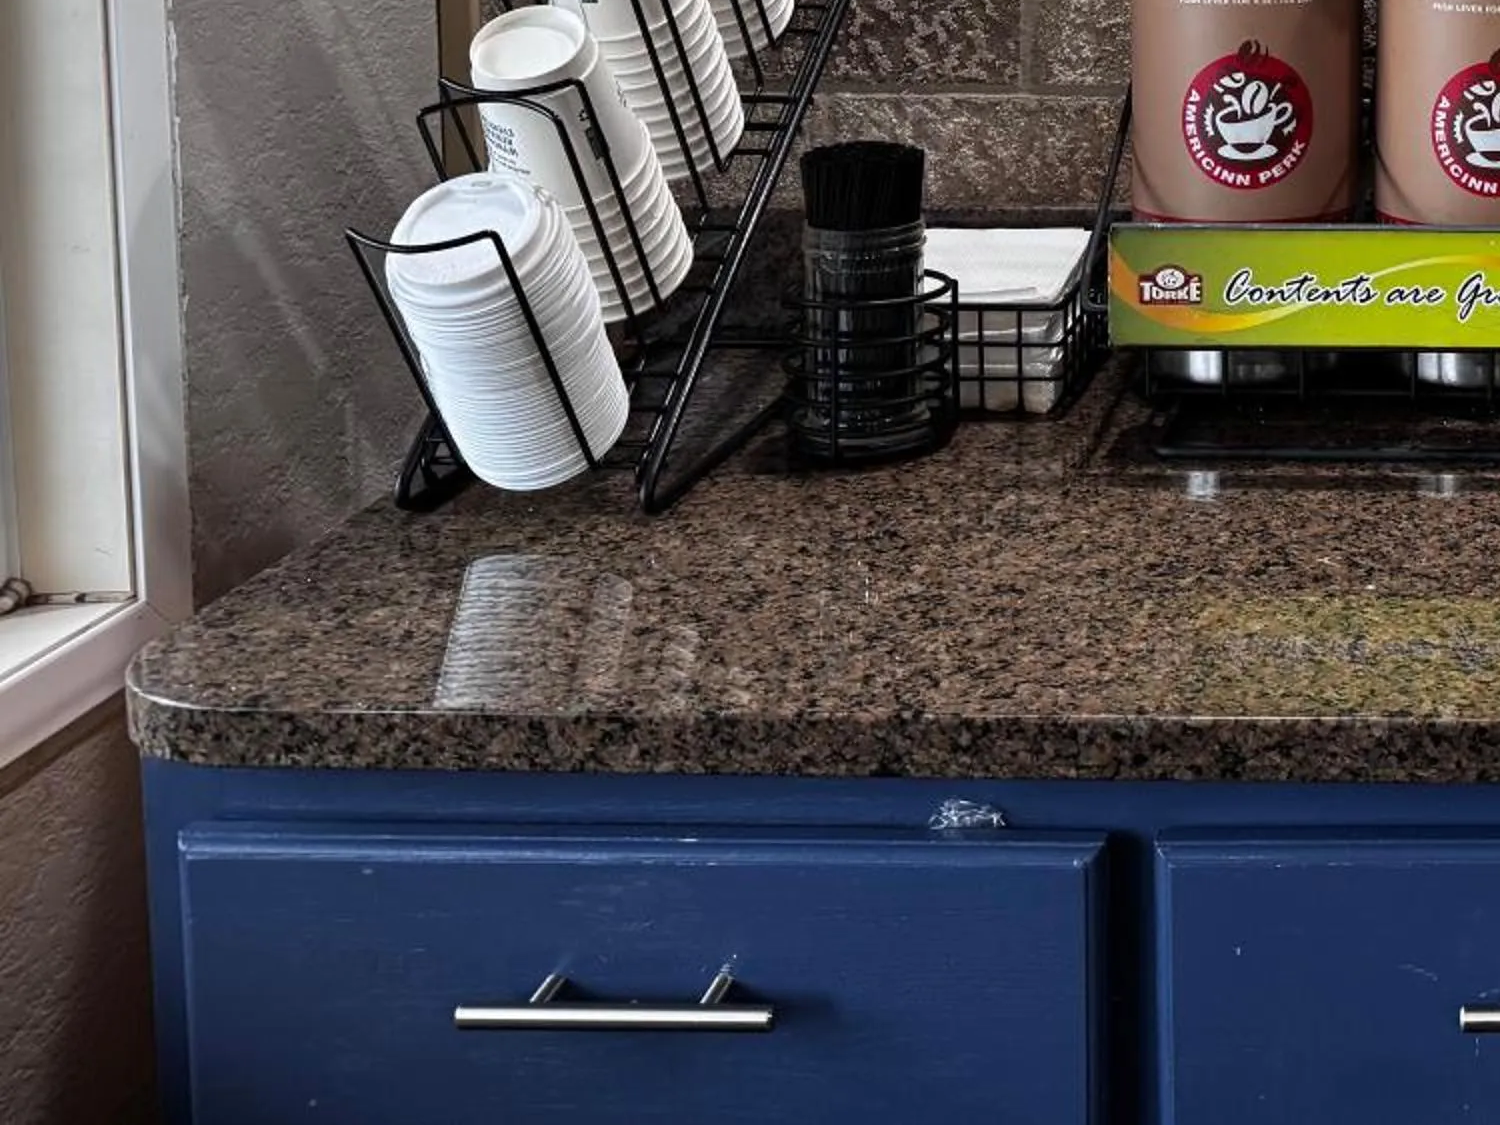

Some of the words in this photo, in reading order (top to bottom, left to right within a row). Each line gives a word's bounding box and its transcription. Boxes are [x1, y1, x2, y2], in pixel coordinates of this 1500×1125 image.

[1455, 3, 1483, 13] LEVER
[1185, 89, 1251, 186] AMERICINN
[1258, 139, 1306, 184] PERK
[1434, 95, 1498, 194] AMERICINN
[1225, 269, 1378, 306] Contents
[1384, 284, 1446, 306] are
